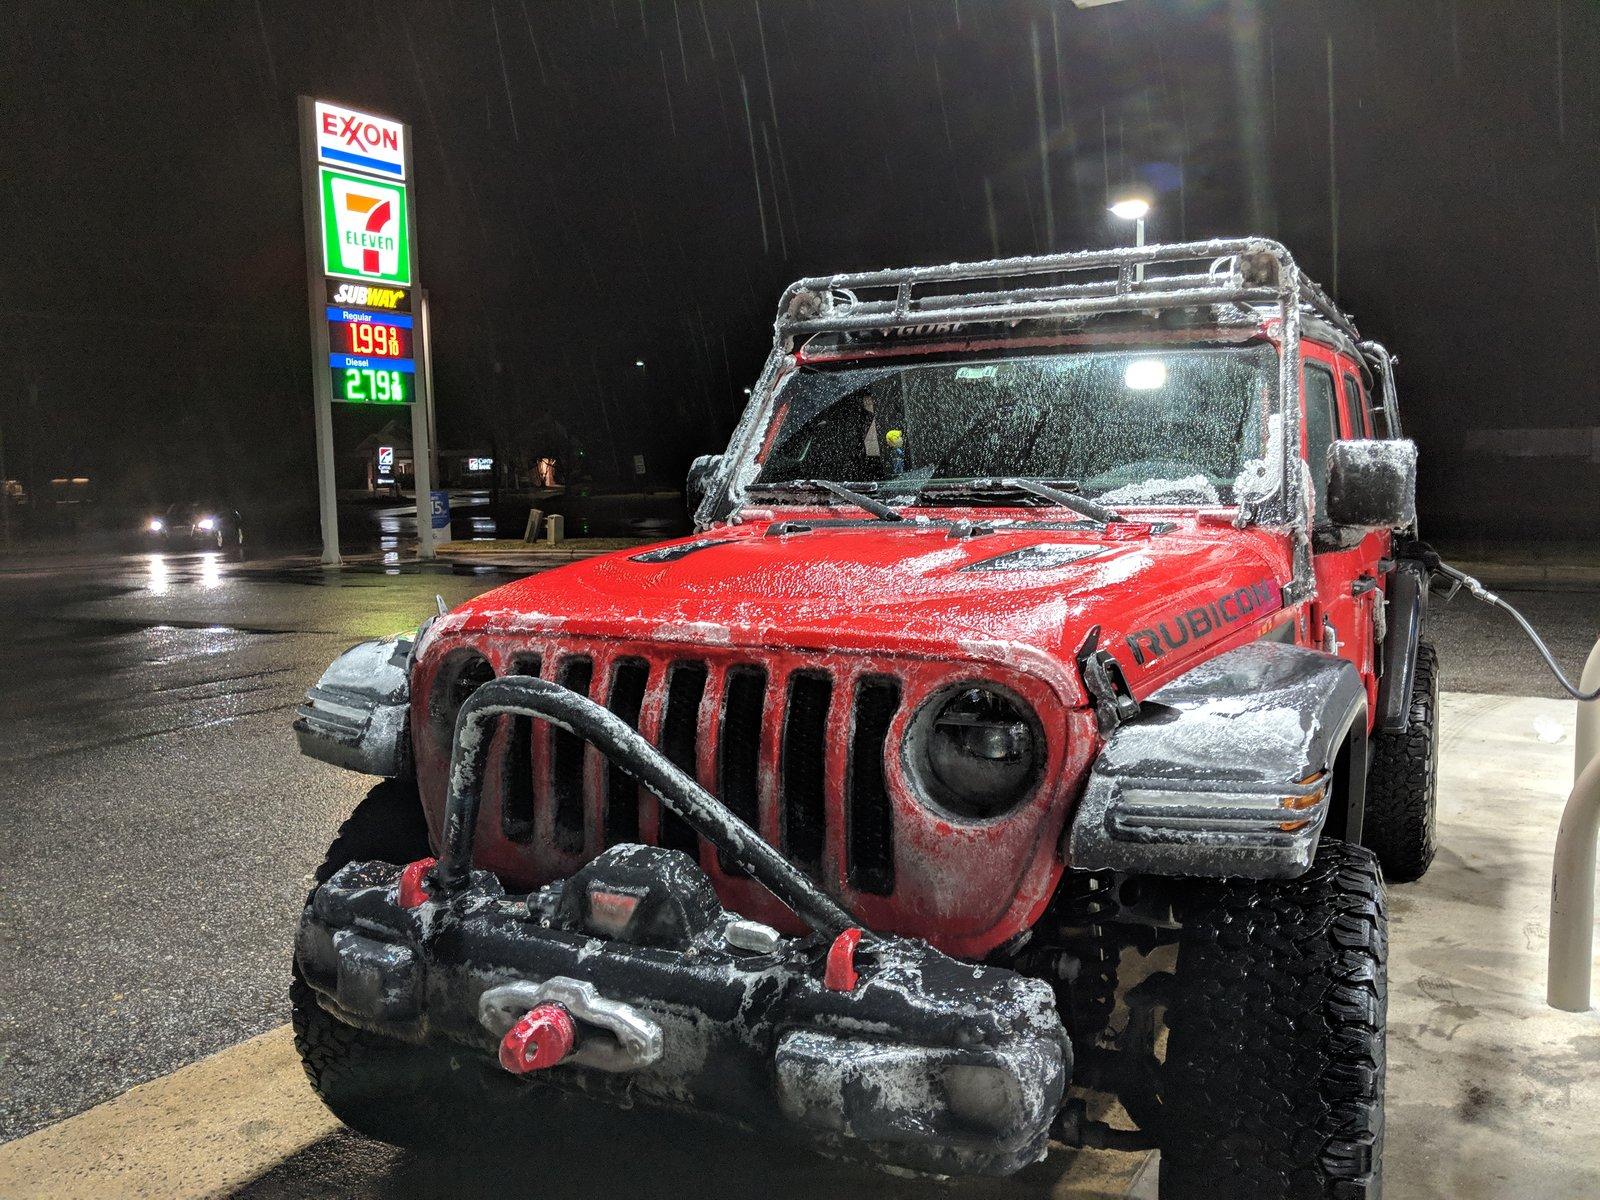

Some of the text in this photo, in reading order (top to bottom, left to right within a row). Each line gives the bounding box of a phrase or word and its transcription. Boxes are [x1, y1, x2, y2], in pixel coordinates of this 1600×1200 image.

[322, 111, 398, 153] EXXON
[346, 192, 391, 273] 7
[333, 284, 405, 309] SUBWAY
[343, 311, 372, 322] Regular
[345, 357, 369, 367] Diesel
[1125, 577, 1274, 665] RUBICON
